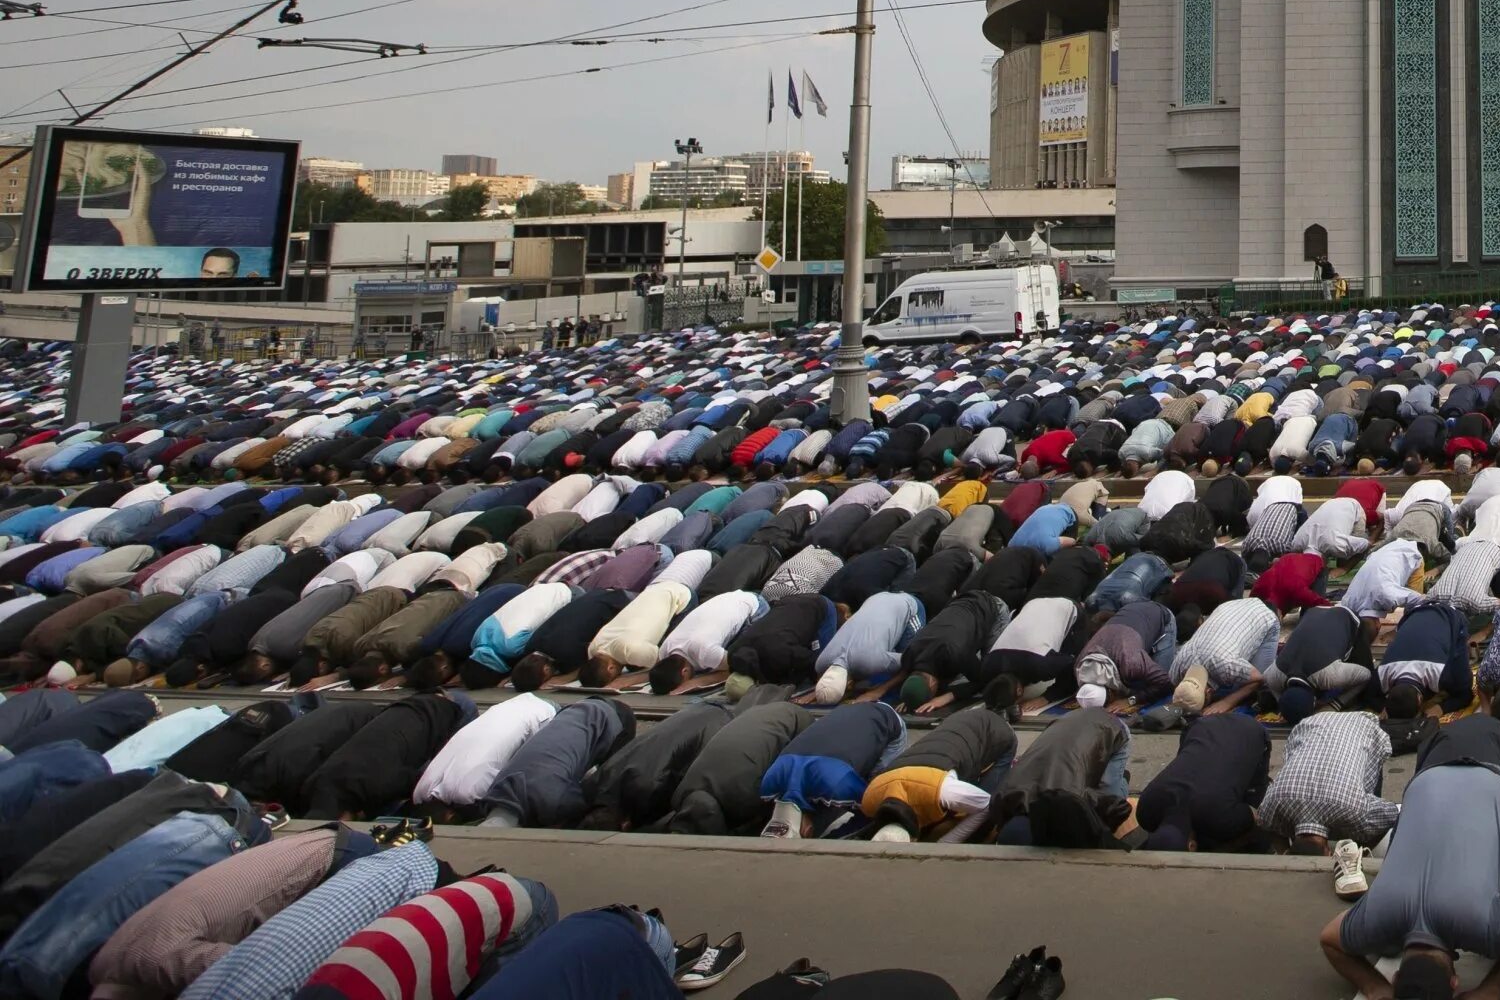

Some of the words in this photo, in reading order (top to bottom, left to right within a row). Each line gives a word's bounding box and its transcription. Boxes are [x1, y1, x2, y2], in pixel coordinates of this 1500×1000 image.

[175, 159, 221, 170] Быстрая
[222, 163, 269, 172] доставка
[188, 171, 238, 181] любимых
[240, 174, 266, 184] кафе
[181, 183, 244, 193] ресторанов
[66, 267, 81, 279] О
[86, 267, 163, 279] ЗВЕРЯХ
